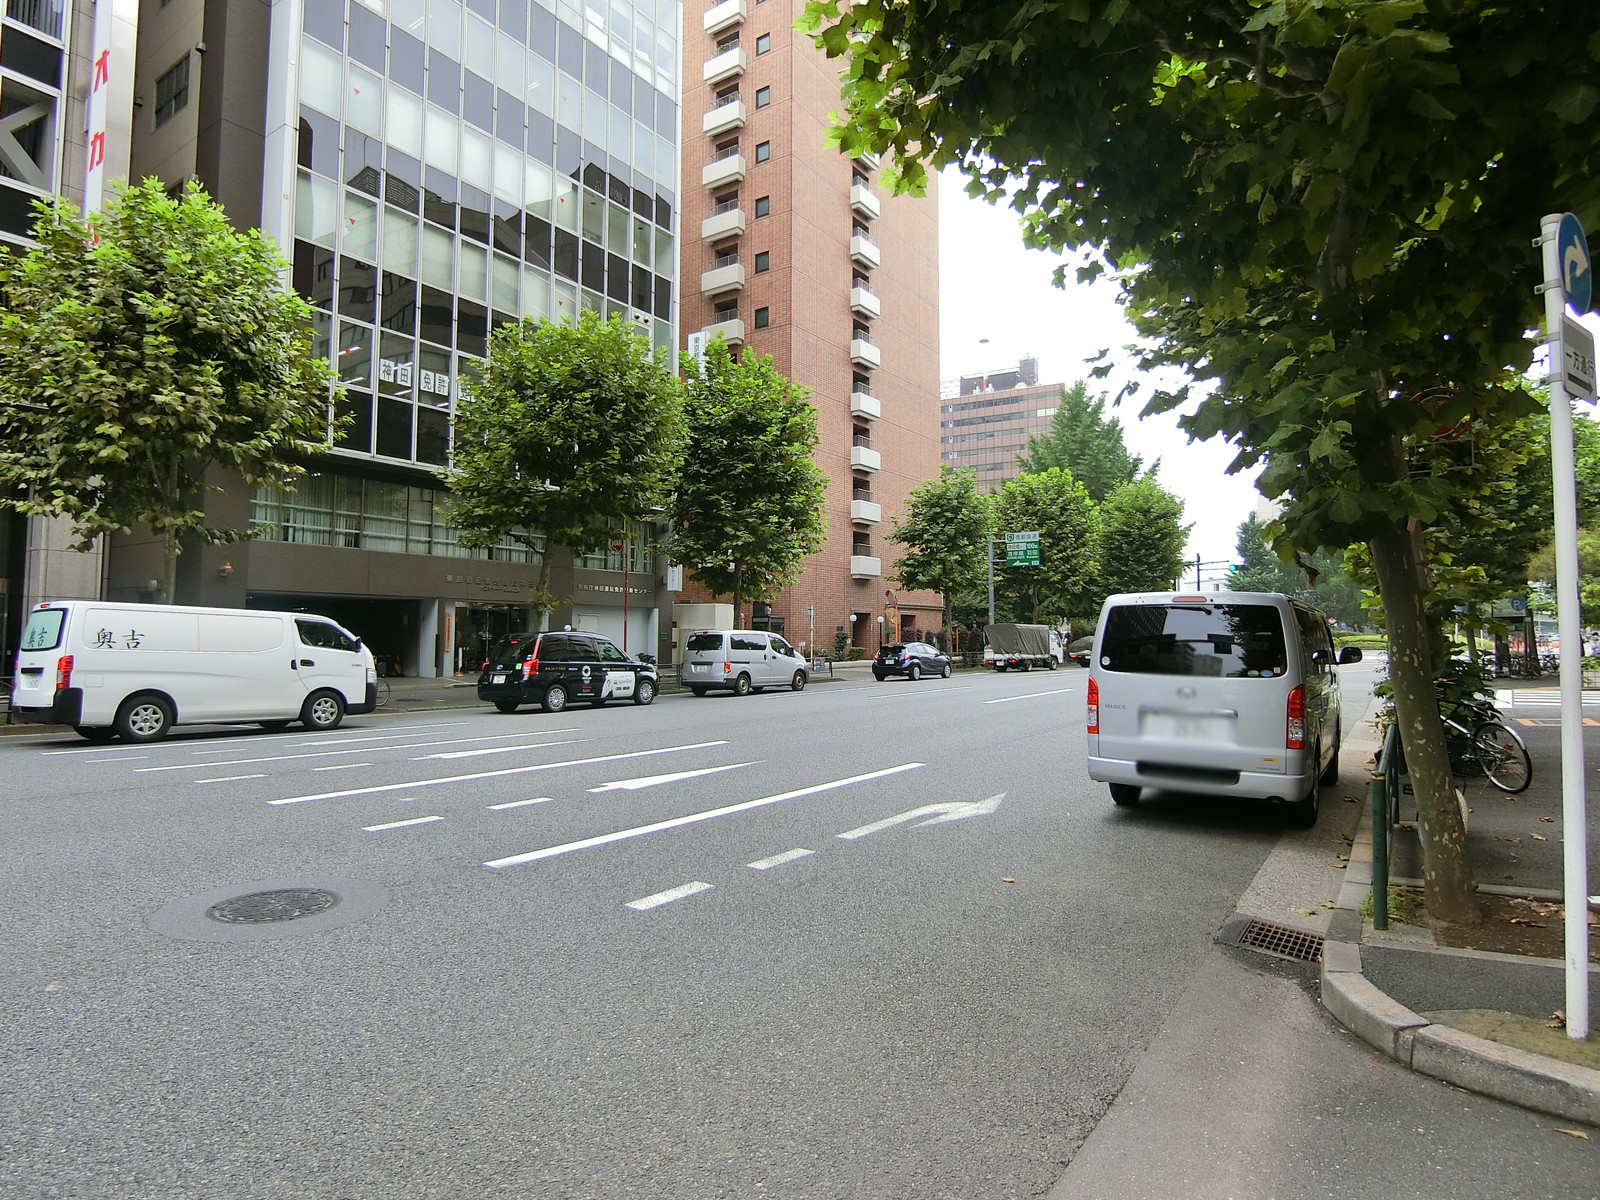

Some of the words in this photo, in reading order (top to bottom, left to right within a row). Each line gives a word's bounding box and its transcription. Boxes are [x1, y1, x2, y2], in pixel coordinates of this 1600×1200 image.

[1565, 351, 1594, 379] 一方通行
[27, 627, 48, 648] 奥吉
[92, 627, 145, 650] 奥吉
